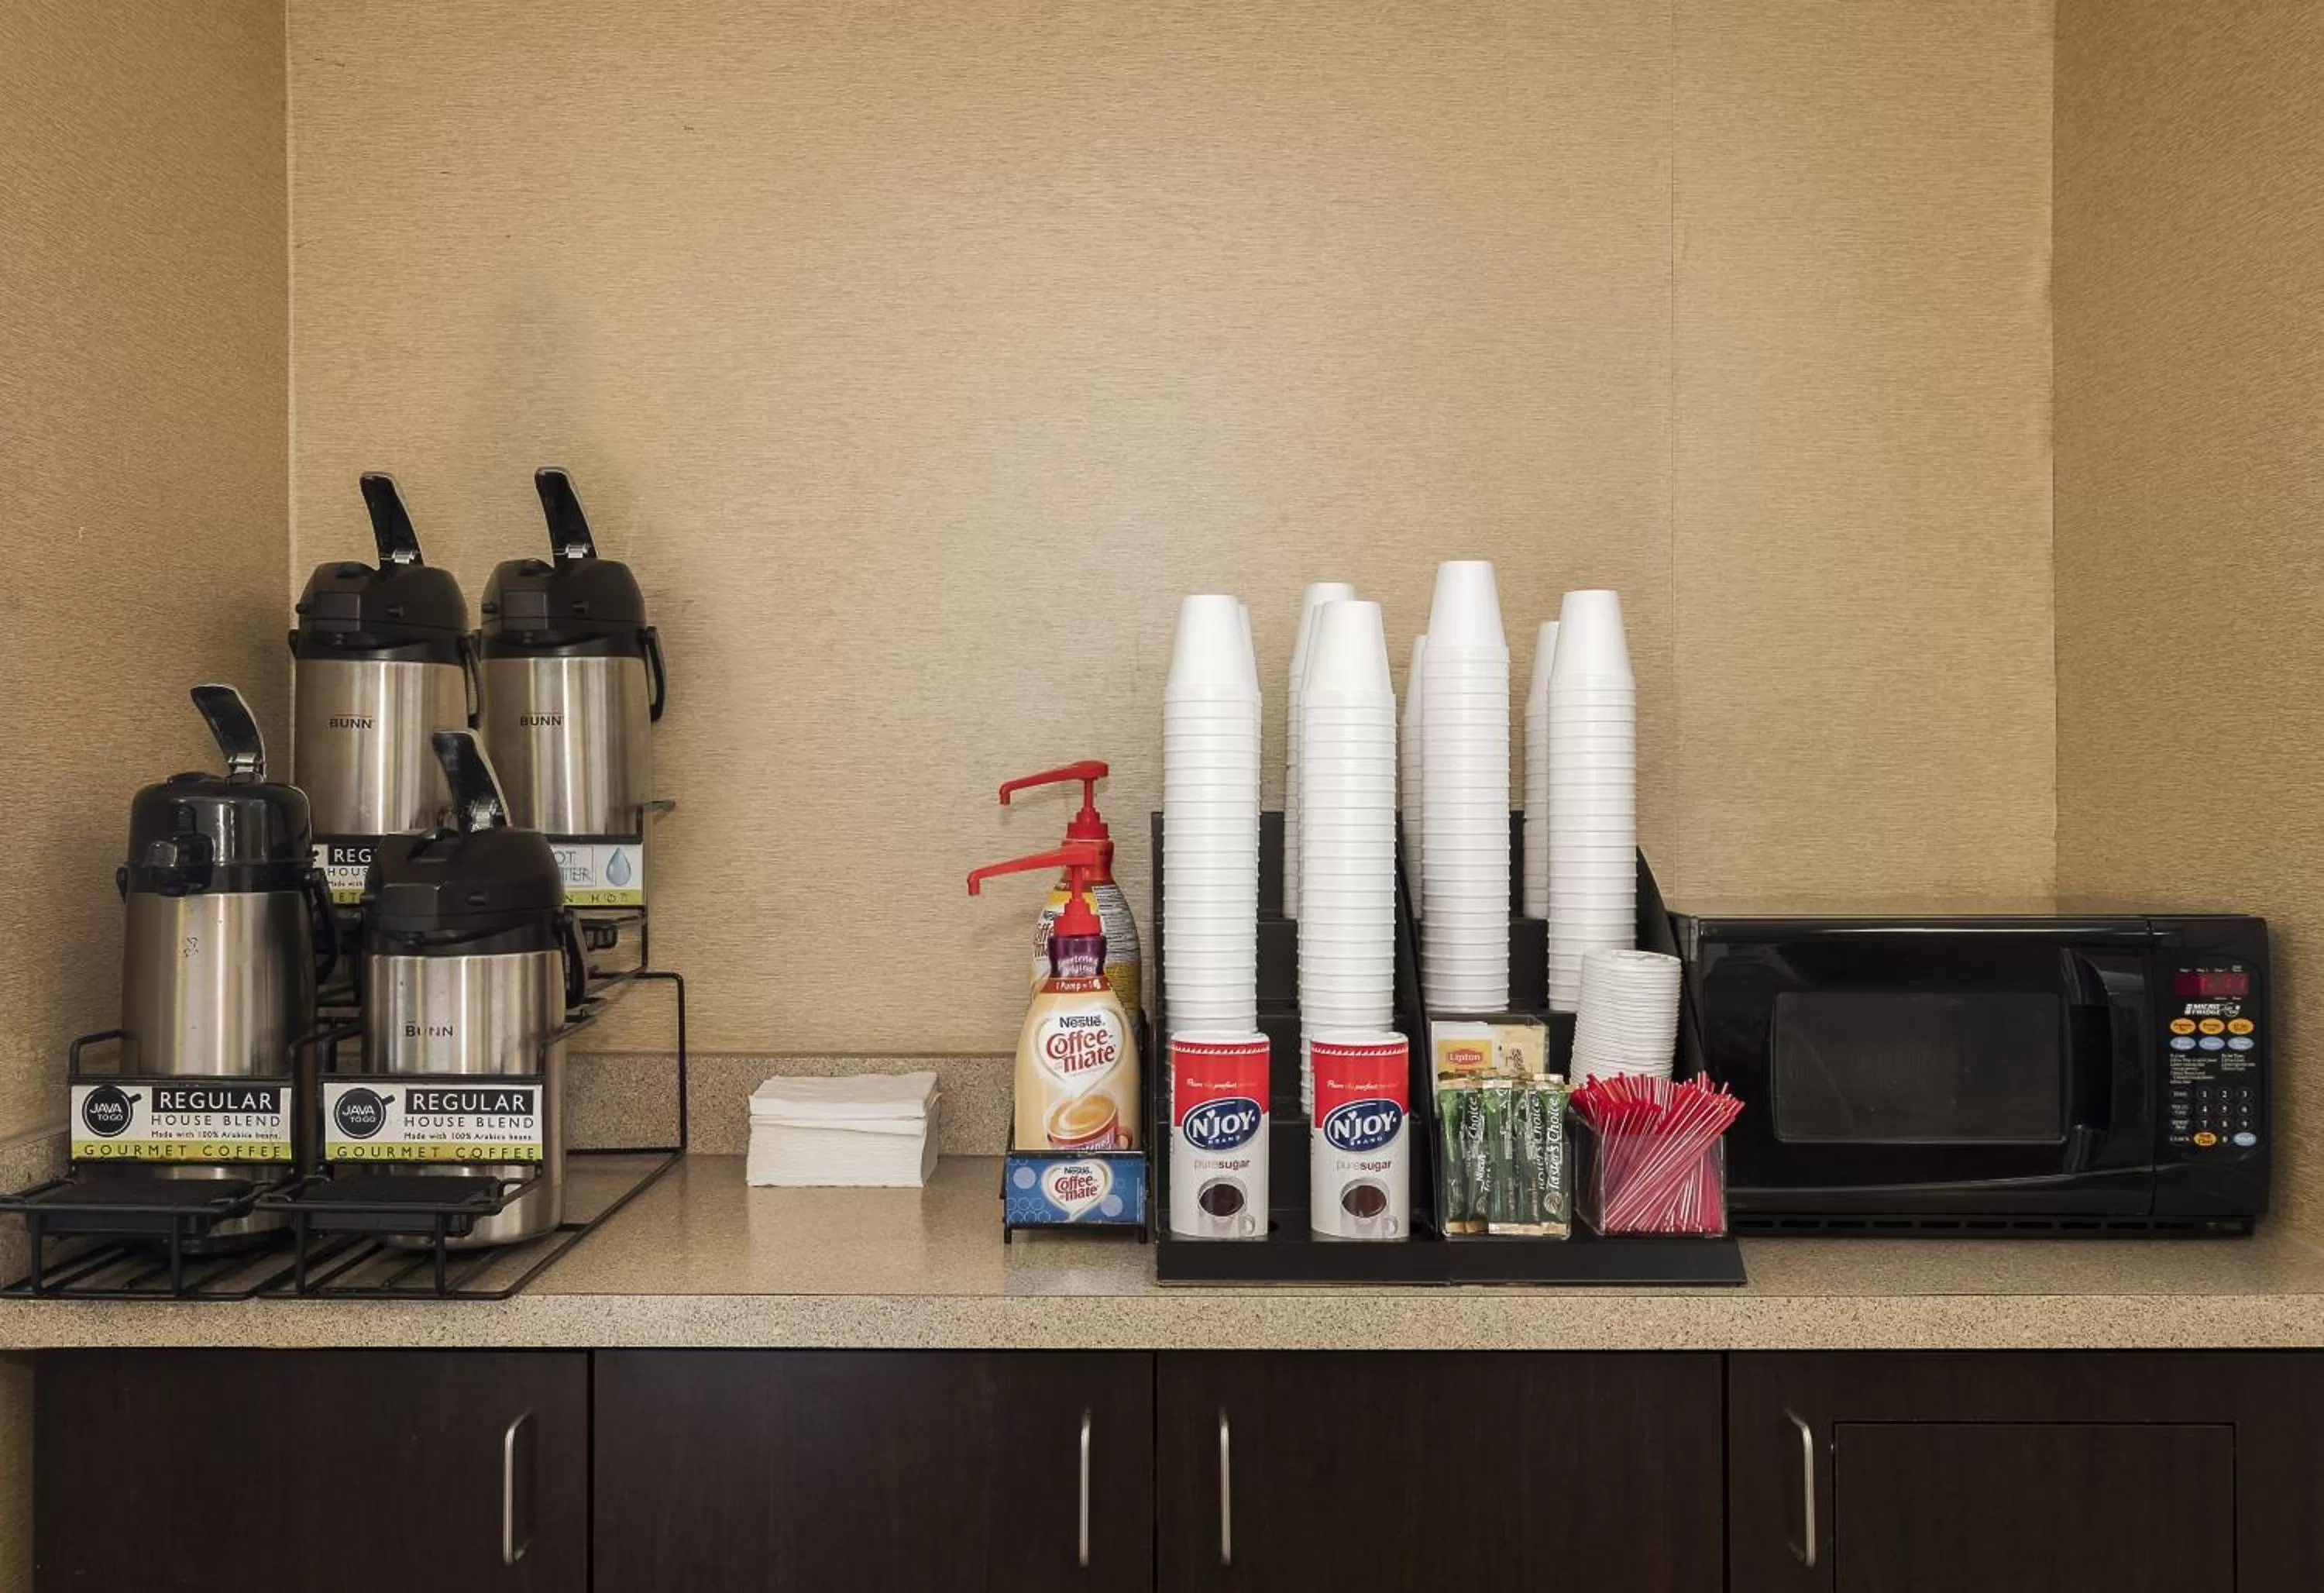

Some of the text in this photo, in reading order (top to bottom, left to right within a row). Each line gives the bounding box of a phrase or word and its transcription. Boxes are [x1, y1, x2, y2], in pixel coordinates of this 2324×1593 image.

[329, 717, 372, 729] BUNN
[520, 716, 562, 726] BUNN
[333, 848, 372, 863] REG
[327, 867, 370, 876] HOUS
[1063, 1045, 1116, 1073] mate
[1449, 1053, 1481, 1062] Lipton
[160, 1091, 273, 1110] REGULAR
[413, 1093, 526, 1112] REGULAR
[90, 1103, 122, 1113] JAVA
[342, 1104, 375, 1116] JAVA
[151, 1115, 281, 1127] HOUSE BLEND
[404, 1116, 534, 1129] HOUSE BLEND
[1547, 1097, 1560, 1143] Choice
[84, 1144, 281, 1158] GOURMET COFFEE
[337, 1146, 534, 1159] GOURMET COFFEE
[1065, 1186, 1098, 1202] mate
